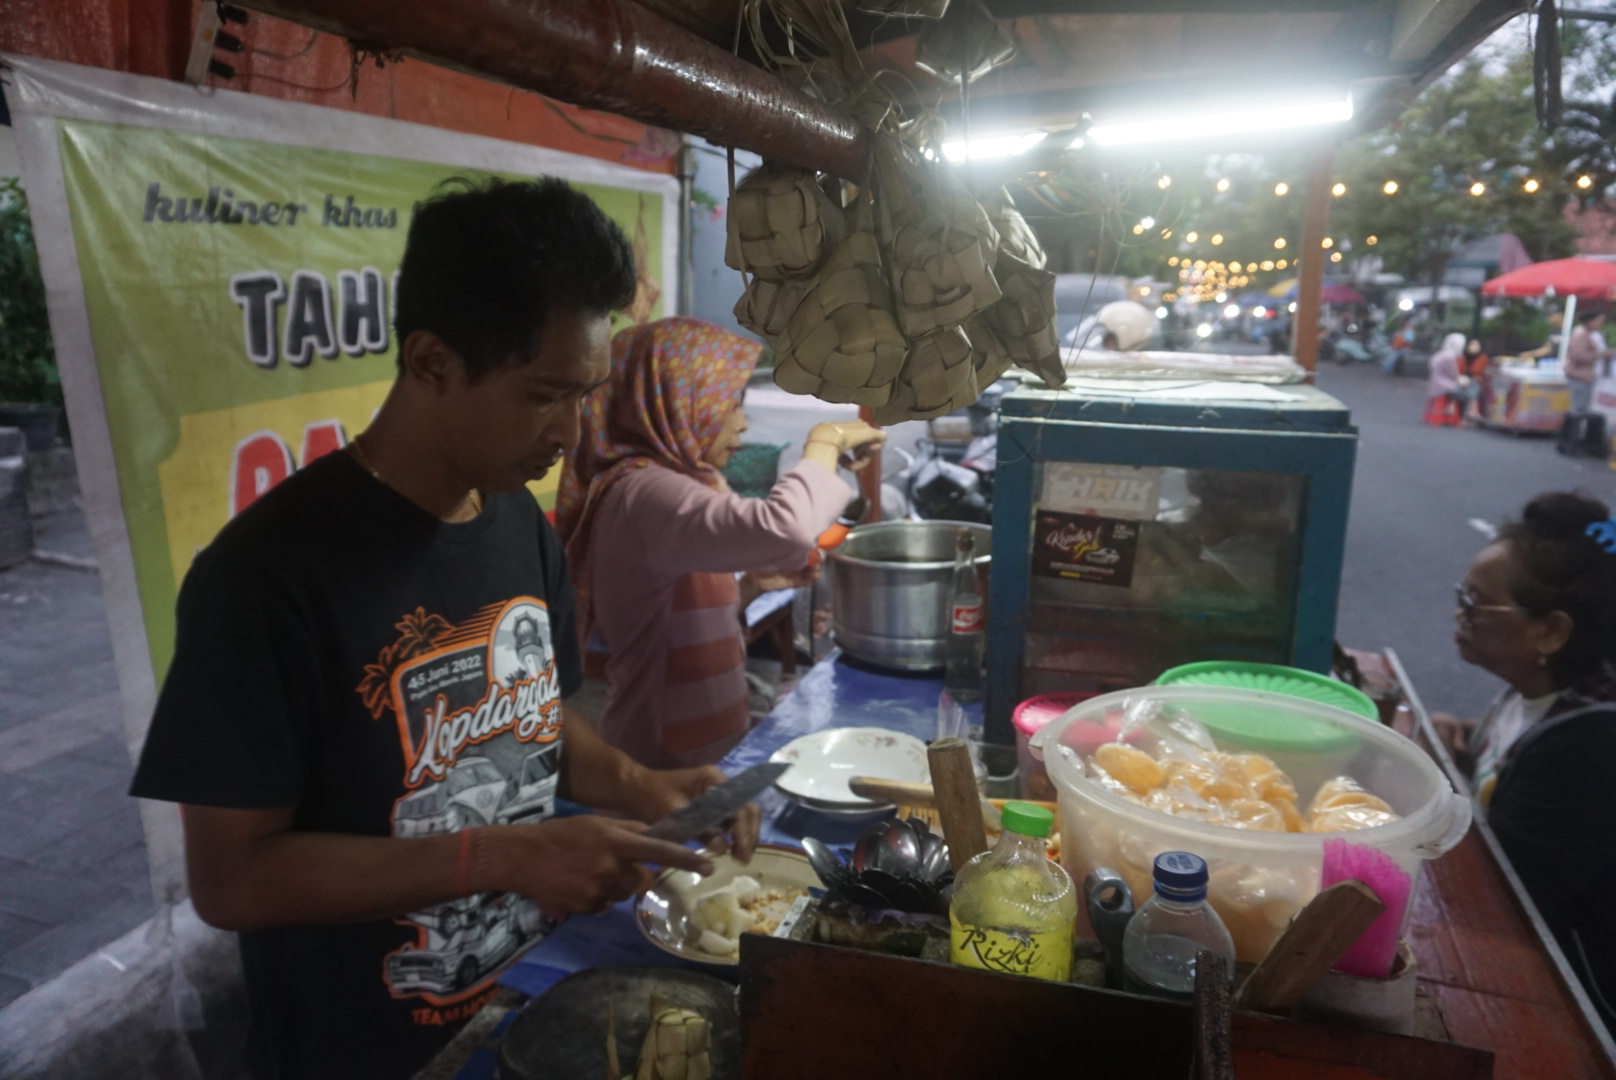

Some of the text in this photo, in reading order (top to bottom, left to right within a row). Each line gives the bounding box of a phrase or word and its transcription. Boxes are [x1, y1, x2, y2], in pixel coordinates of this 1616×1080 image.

[143, 182, 398, 229] kuliner khas
[230, 266, 400, 369] TAH
[451, 654, 482, 673] 2022
[958, 929, 1045, 974] Rizki
